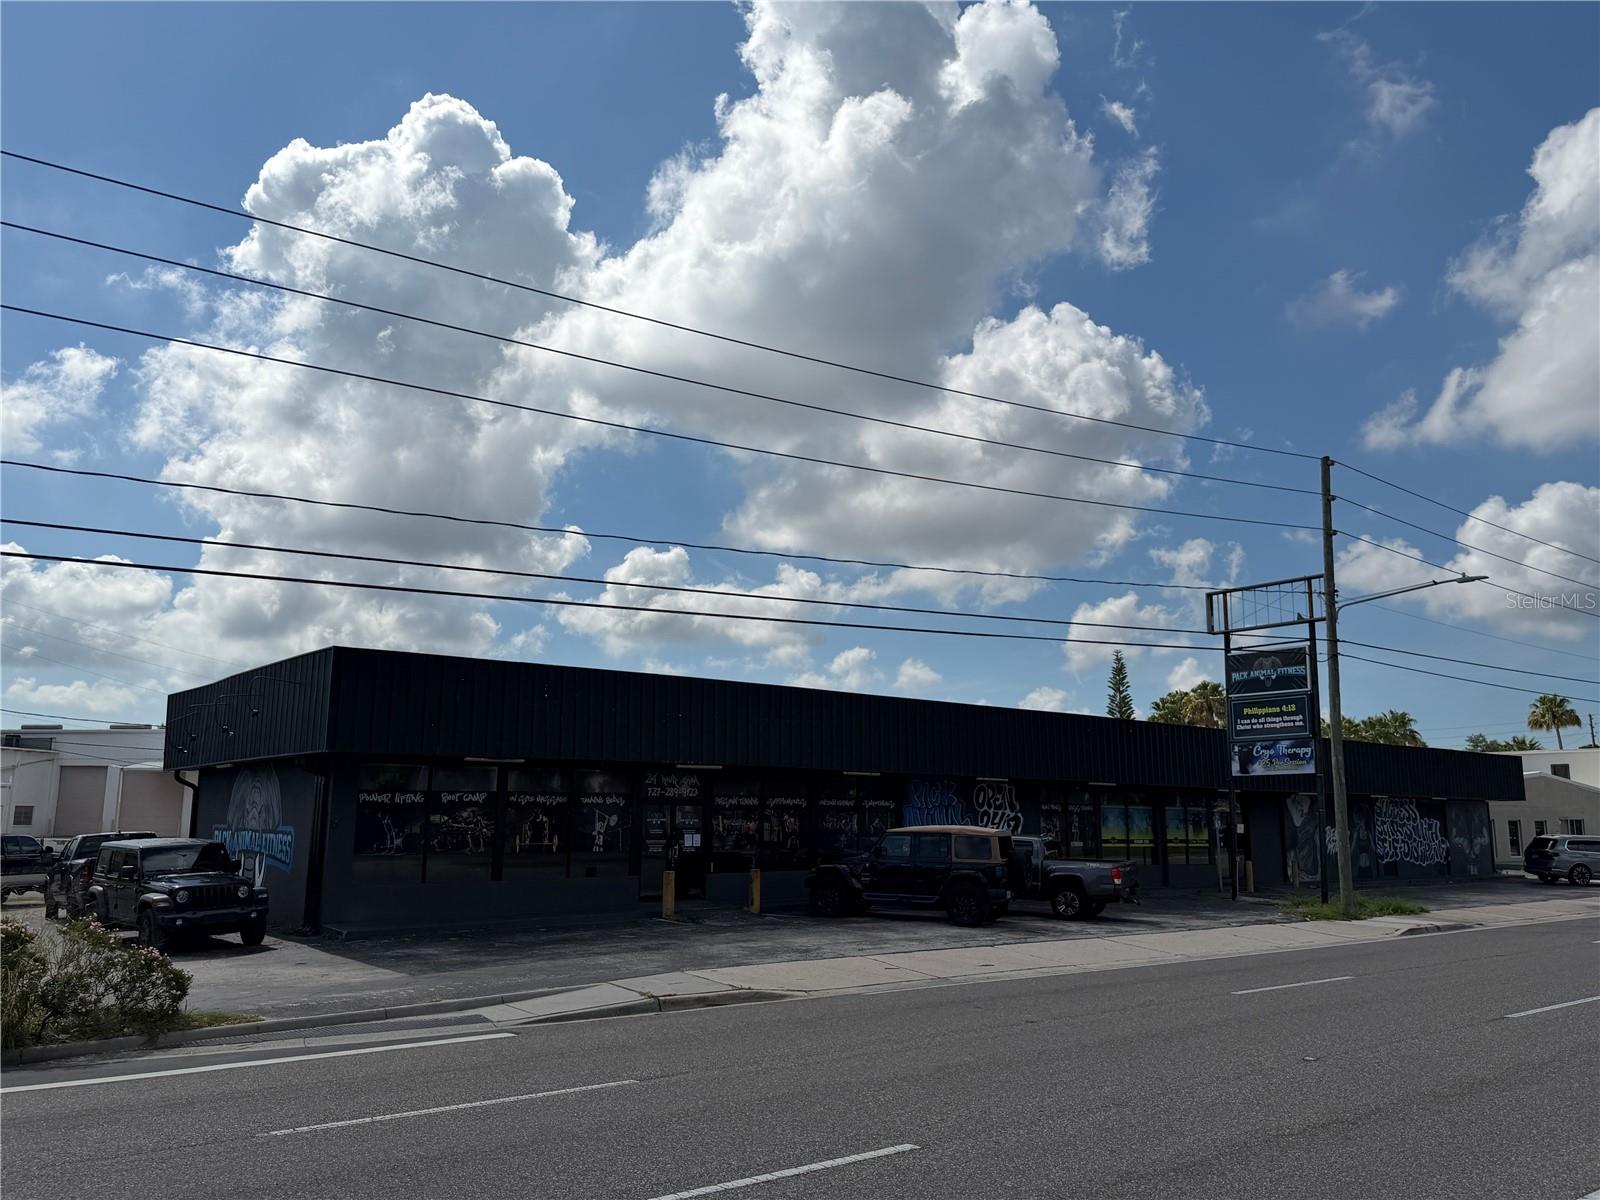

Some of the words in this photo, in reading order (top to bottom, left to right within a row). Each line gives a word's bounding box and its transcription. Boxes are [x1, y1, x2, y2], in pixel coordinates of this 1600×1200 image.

[1231, 671, 1248, 682] PACK
[1249, 668, 1275, 678] ANIMAL
[1277, 666, 1305, 675] FITNESS
[1243, 706, 1280, 715] Philippians
[1281, 704, 1296, 712] 4:13
[1264, 721, 1294, 729] strengthens
[1253, 745, 1275, 759] Cryo
[1276, 744, 1312, 758] Therapy
[463, 792, 488, 803] CAMP
[262, 832, 293, 864] FITNESS
